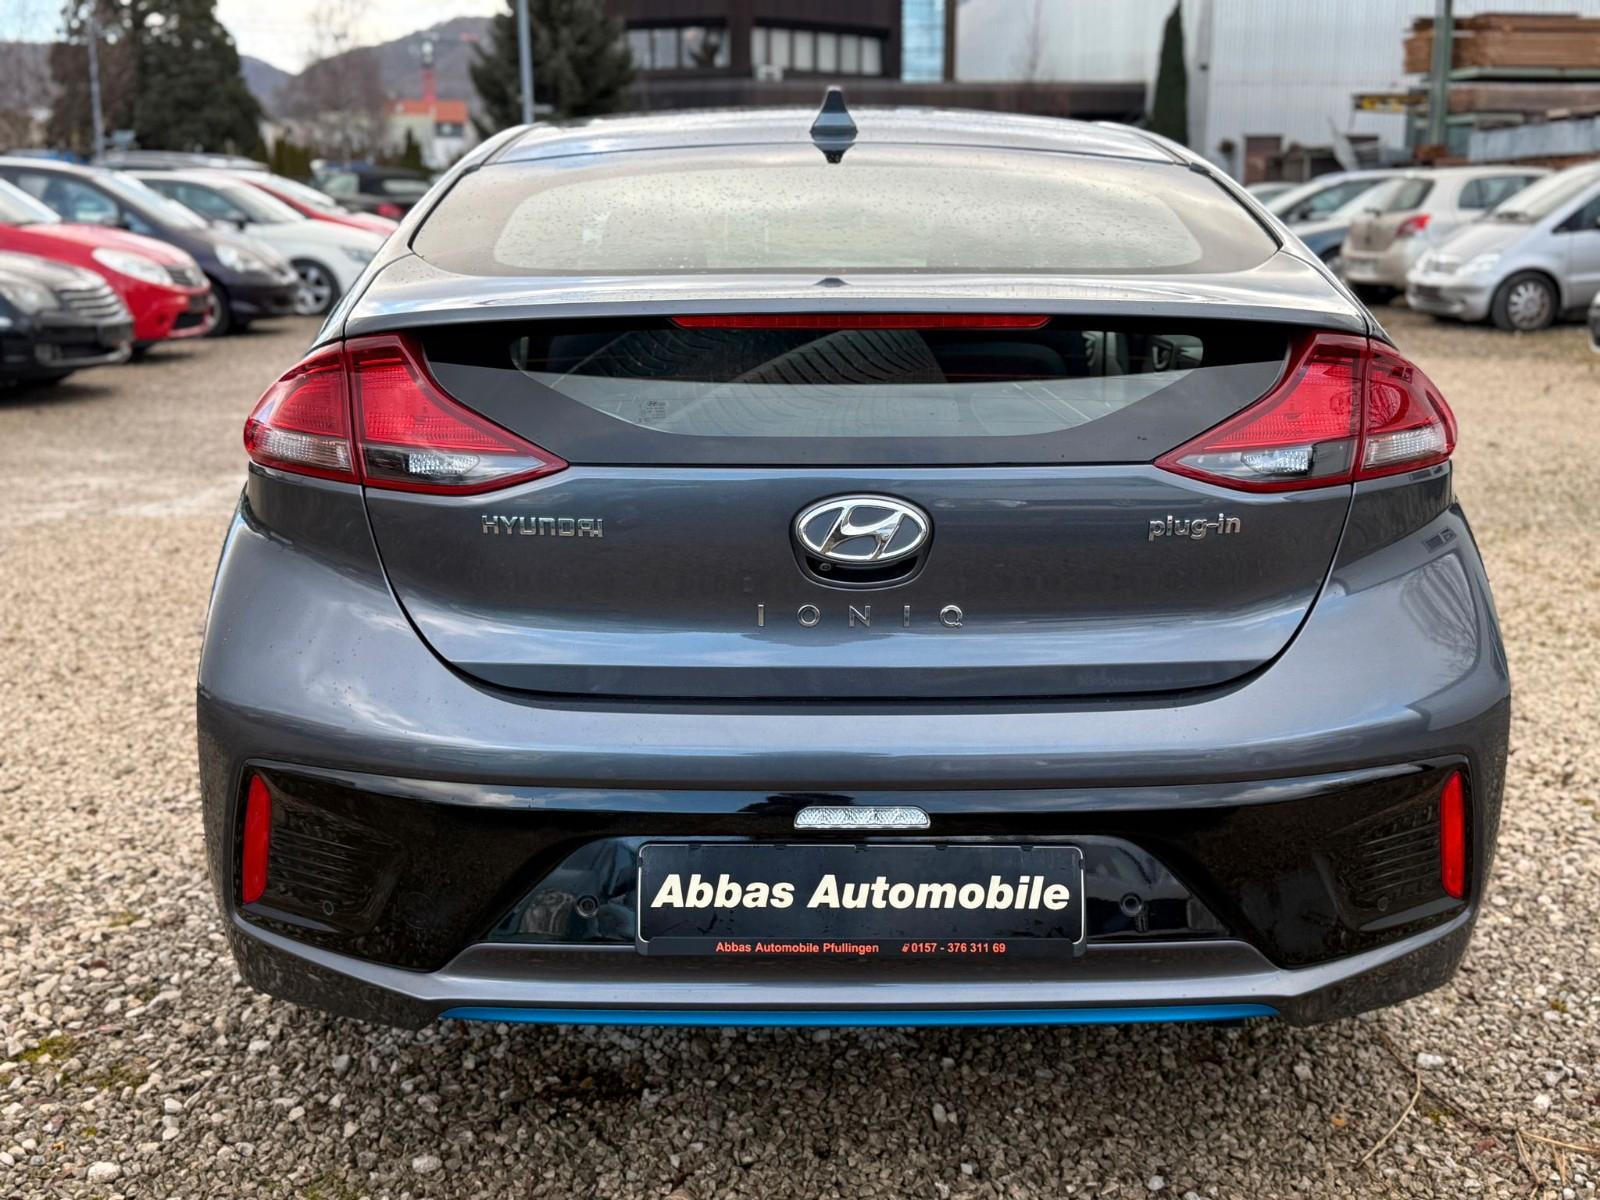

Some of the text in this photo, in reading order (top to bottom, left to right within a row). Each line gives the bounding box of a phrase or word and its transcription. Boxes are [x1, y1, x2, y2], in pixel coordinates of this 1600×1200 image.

[481, 515, 604, 538] HYUNDAI
[1148, 512, 1241, 542] plug-in
[757, 603, 964, 628] IONIQ
[650, 873, 1071, 910] Abbas Automobile
[715, 941, 752, 953] Abbas
[754, 941, 820, 954] Automobile
[822, 942, 880, 956] Pfullingen
[910, 942, 938, 954] 0157
[947, 942, 968, 954] 376
[969, 942, 990, 954] 311
[992, 942, 1007, 954] 69
